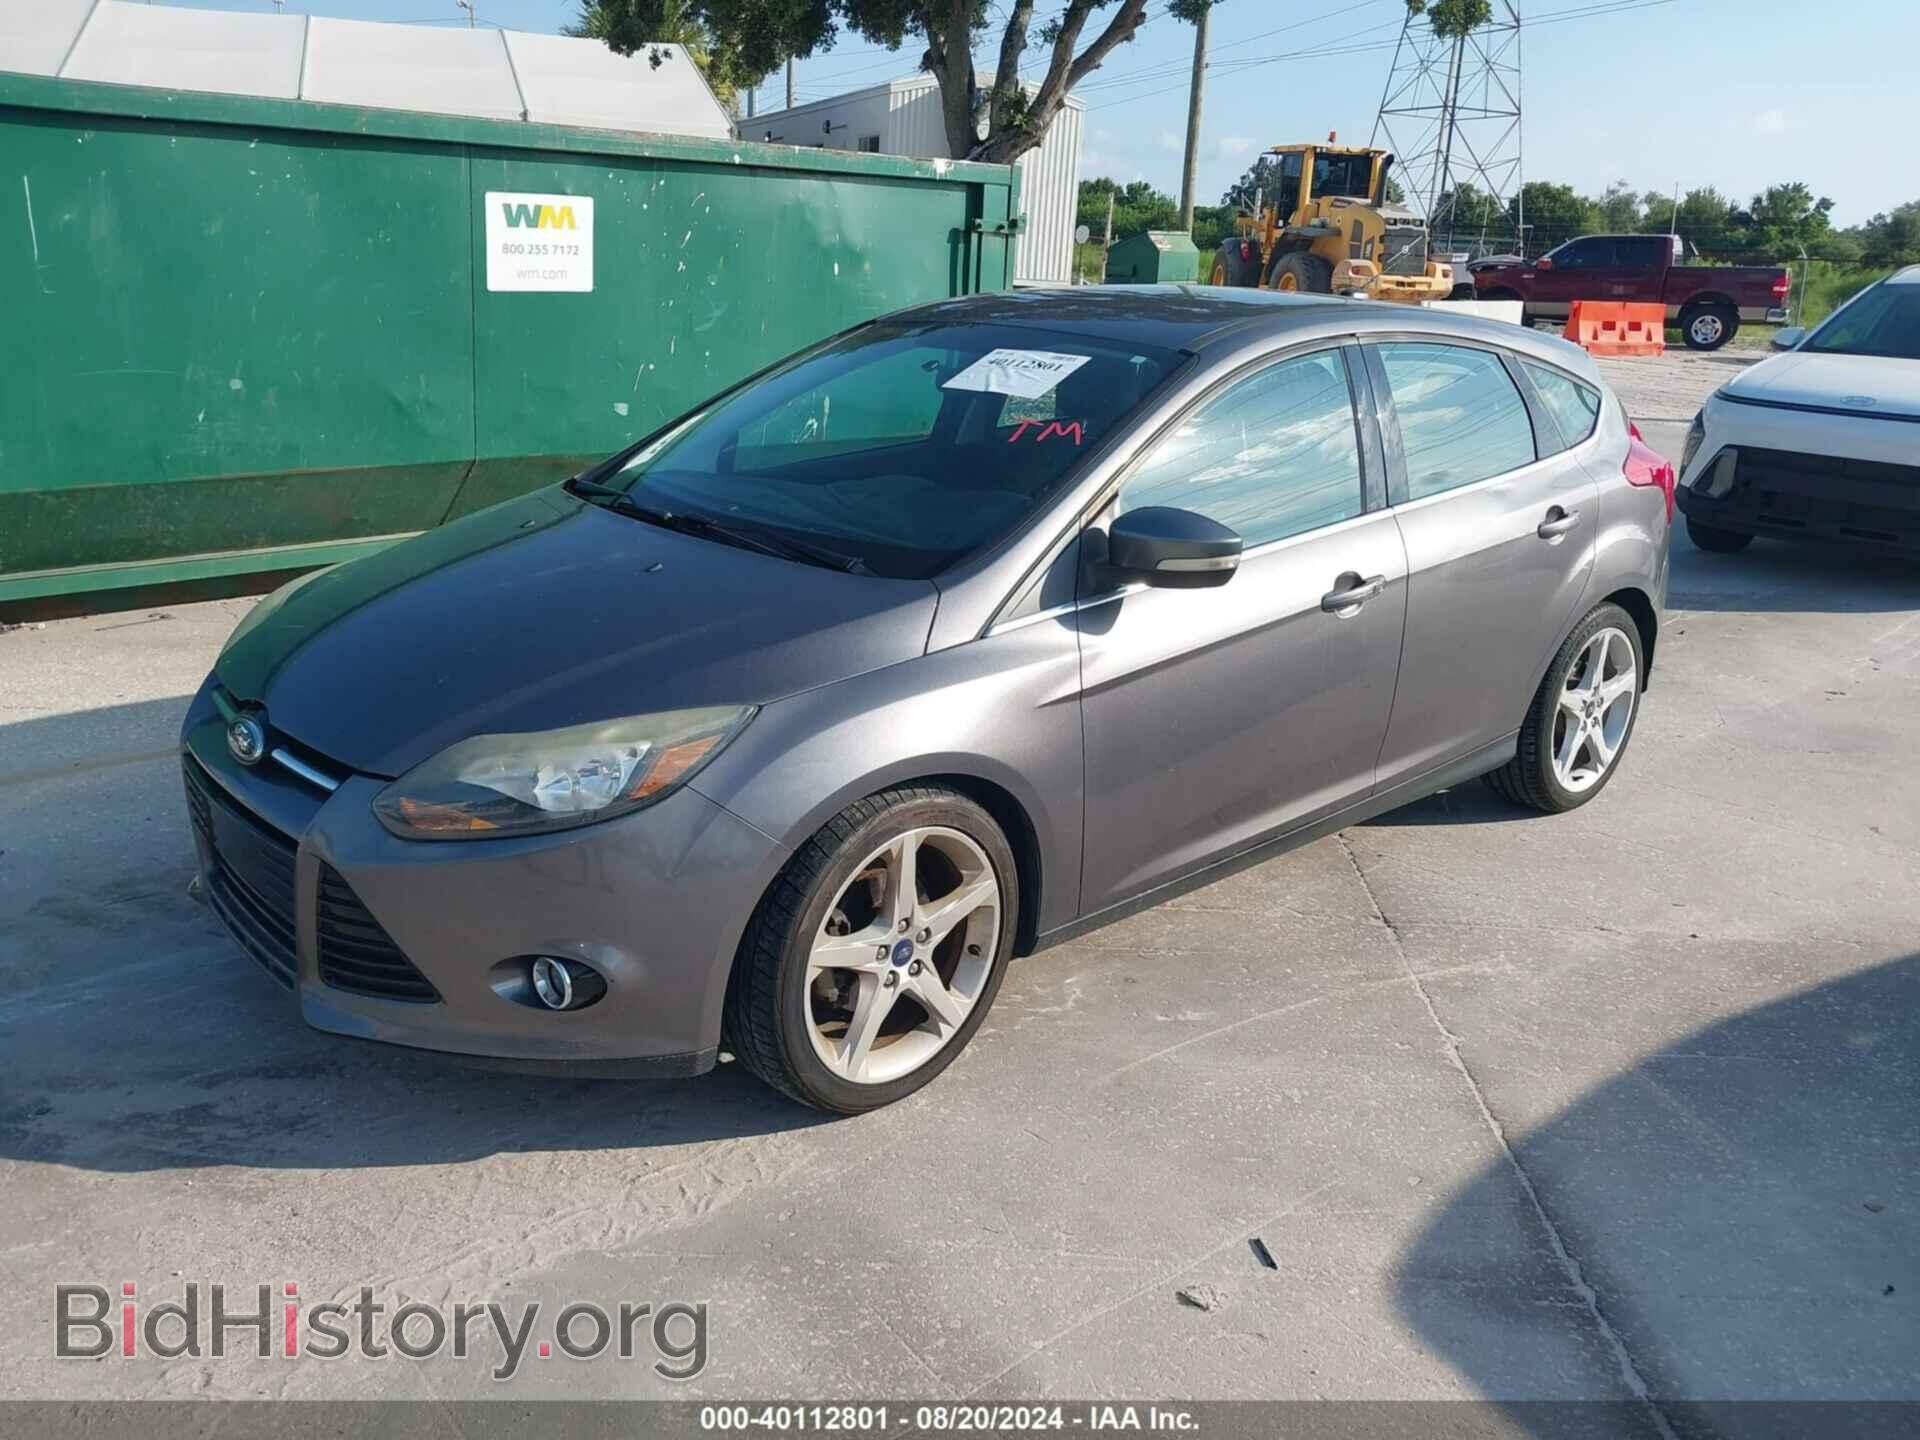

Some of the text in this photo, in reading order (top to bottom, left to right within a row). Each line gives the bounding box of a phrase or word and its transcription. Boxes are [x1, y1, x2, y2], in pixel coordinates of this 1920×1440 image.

[502, 203, 576, 229] WM
[502, 243, 579, 256] 800 255 7172
[516, 269, 568, 280] wm.com
